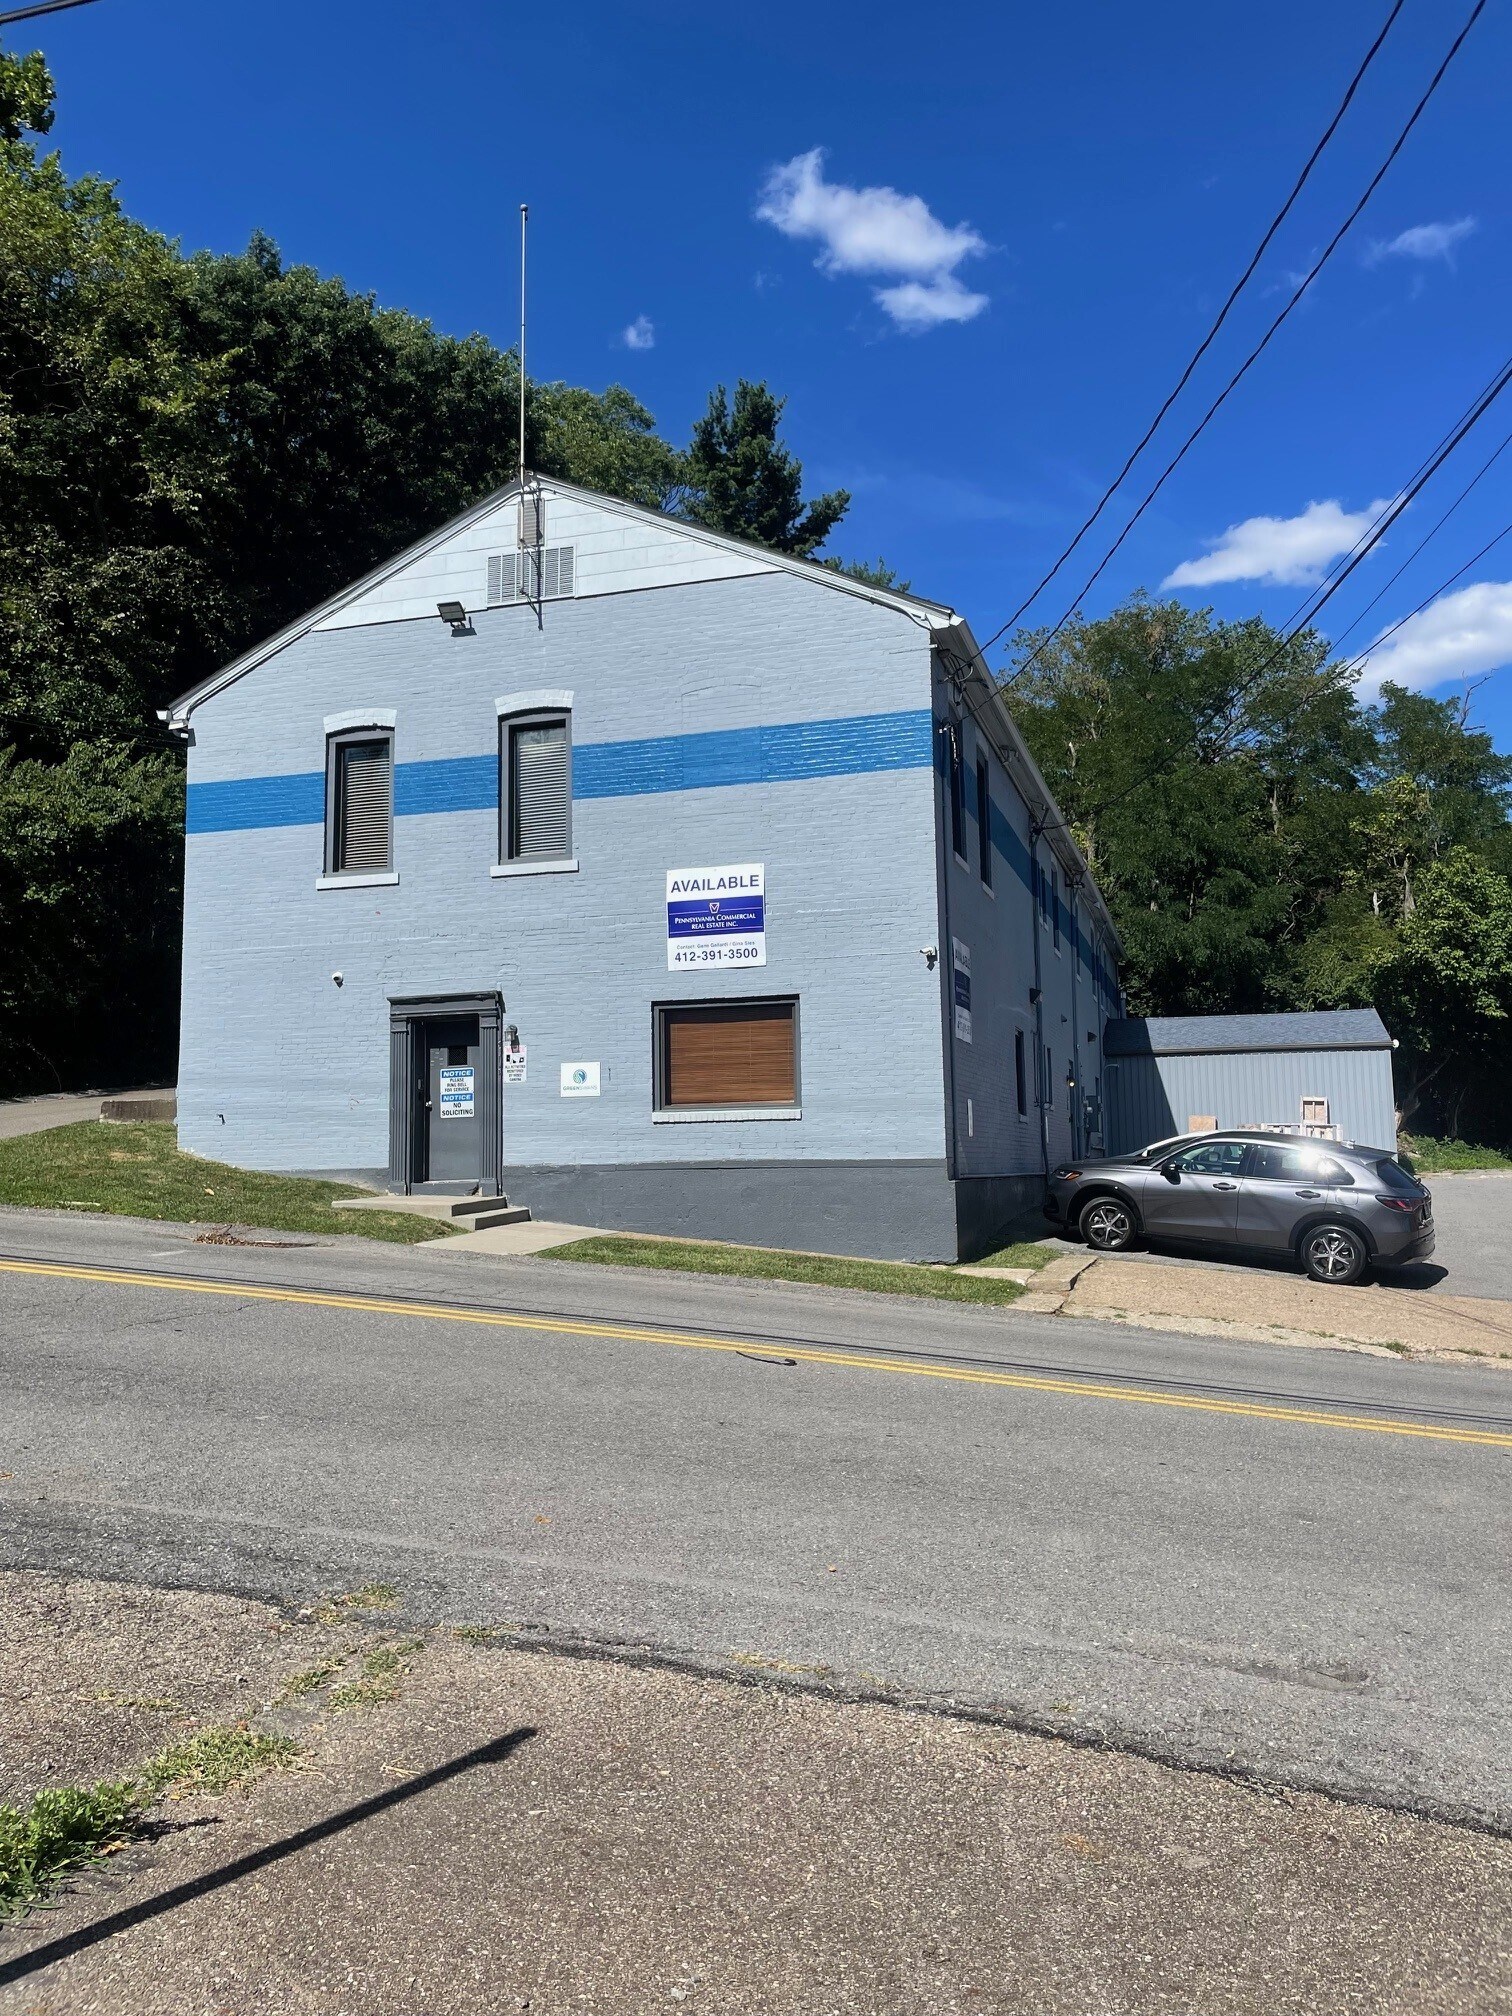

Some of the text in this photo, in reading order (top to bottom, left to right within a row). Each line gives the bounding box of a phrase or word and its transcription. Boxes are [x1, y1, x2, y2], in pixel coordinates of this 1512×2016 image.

[671, 875, 759, 893] AVAILABLE
[675, 913, 756, 924] PENNSYLVANIA COMMERCIAL
[675, 947, 758, 962] 412-391-3500
